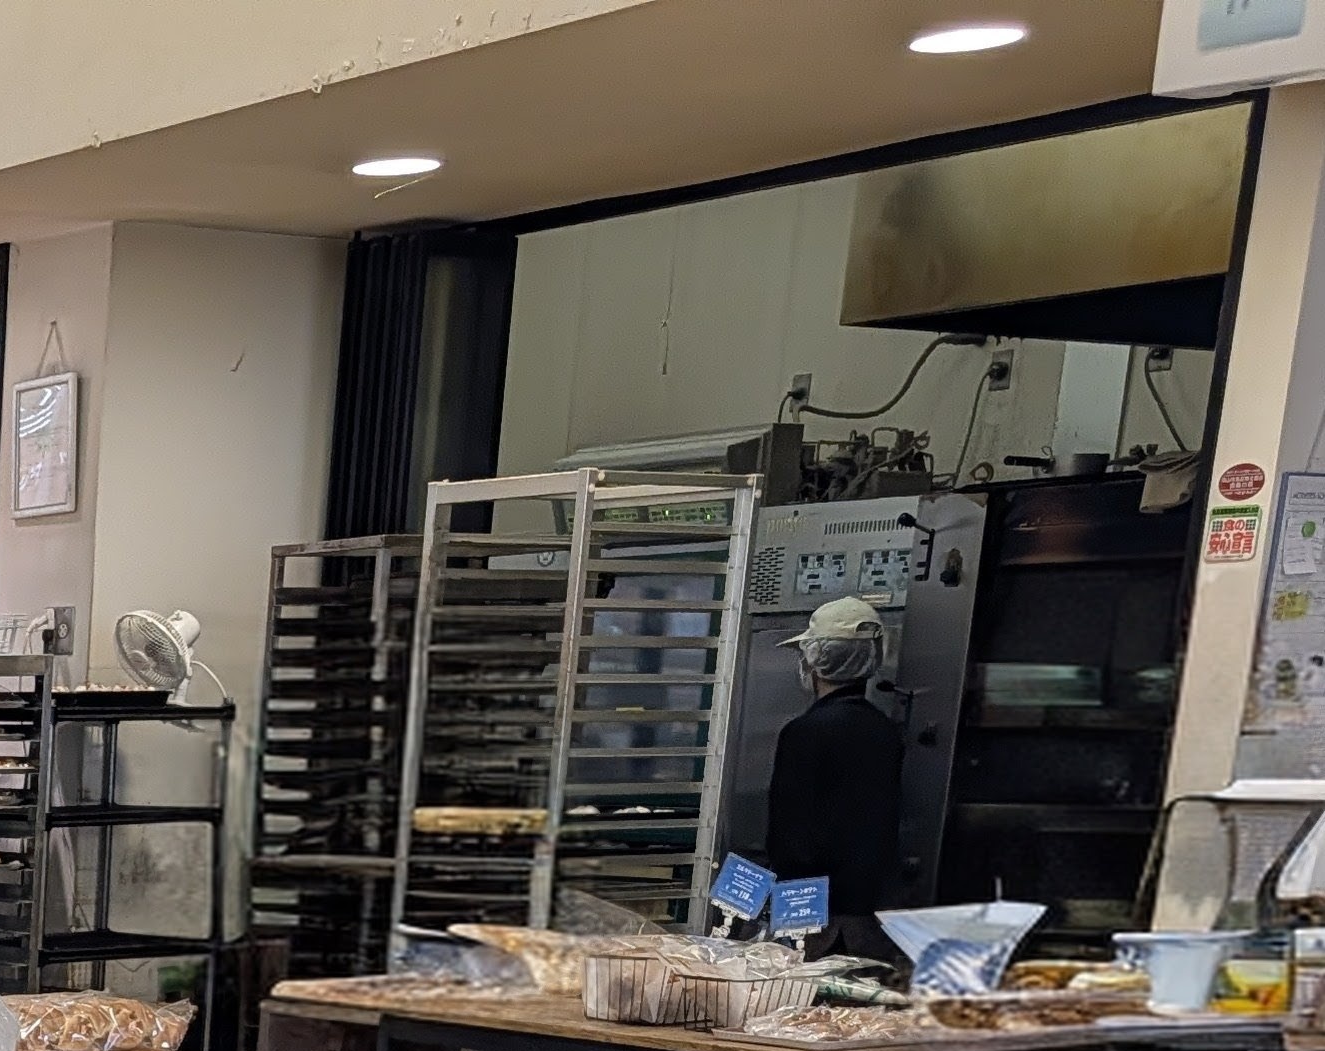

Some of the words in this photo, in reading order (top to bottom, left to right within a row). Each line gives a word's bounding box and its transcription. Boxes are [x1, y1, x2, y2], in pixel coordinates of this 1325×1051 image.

[1223, 519, 1246, 532] 食の
[1207, 532, 1254, 555] 安心宣言
